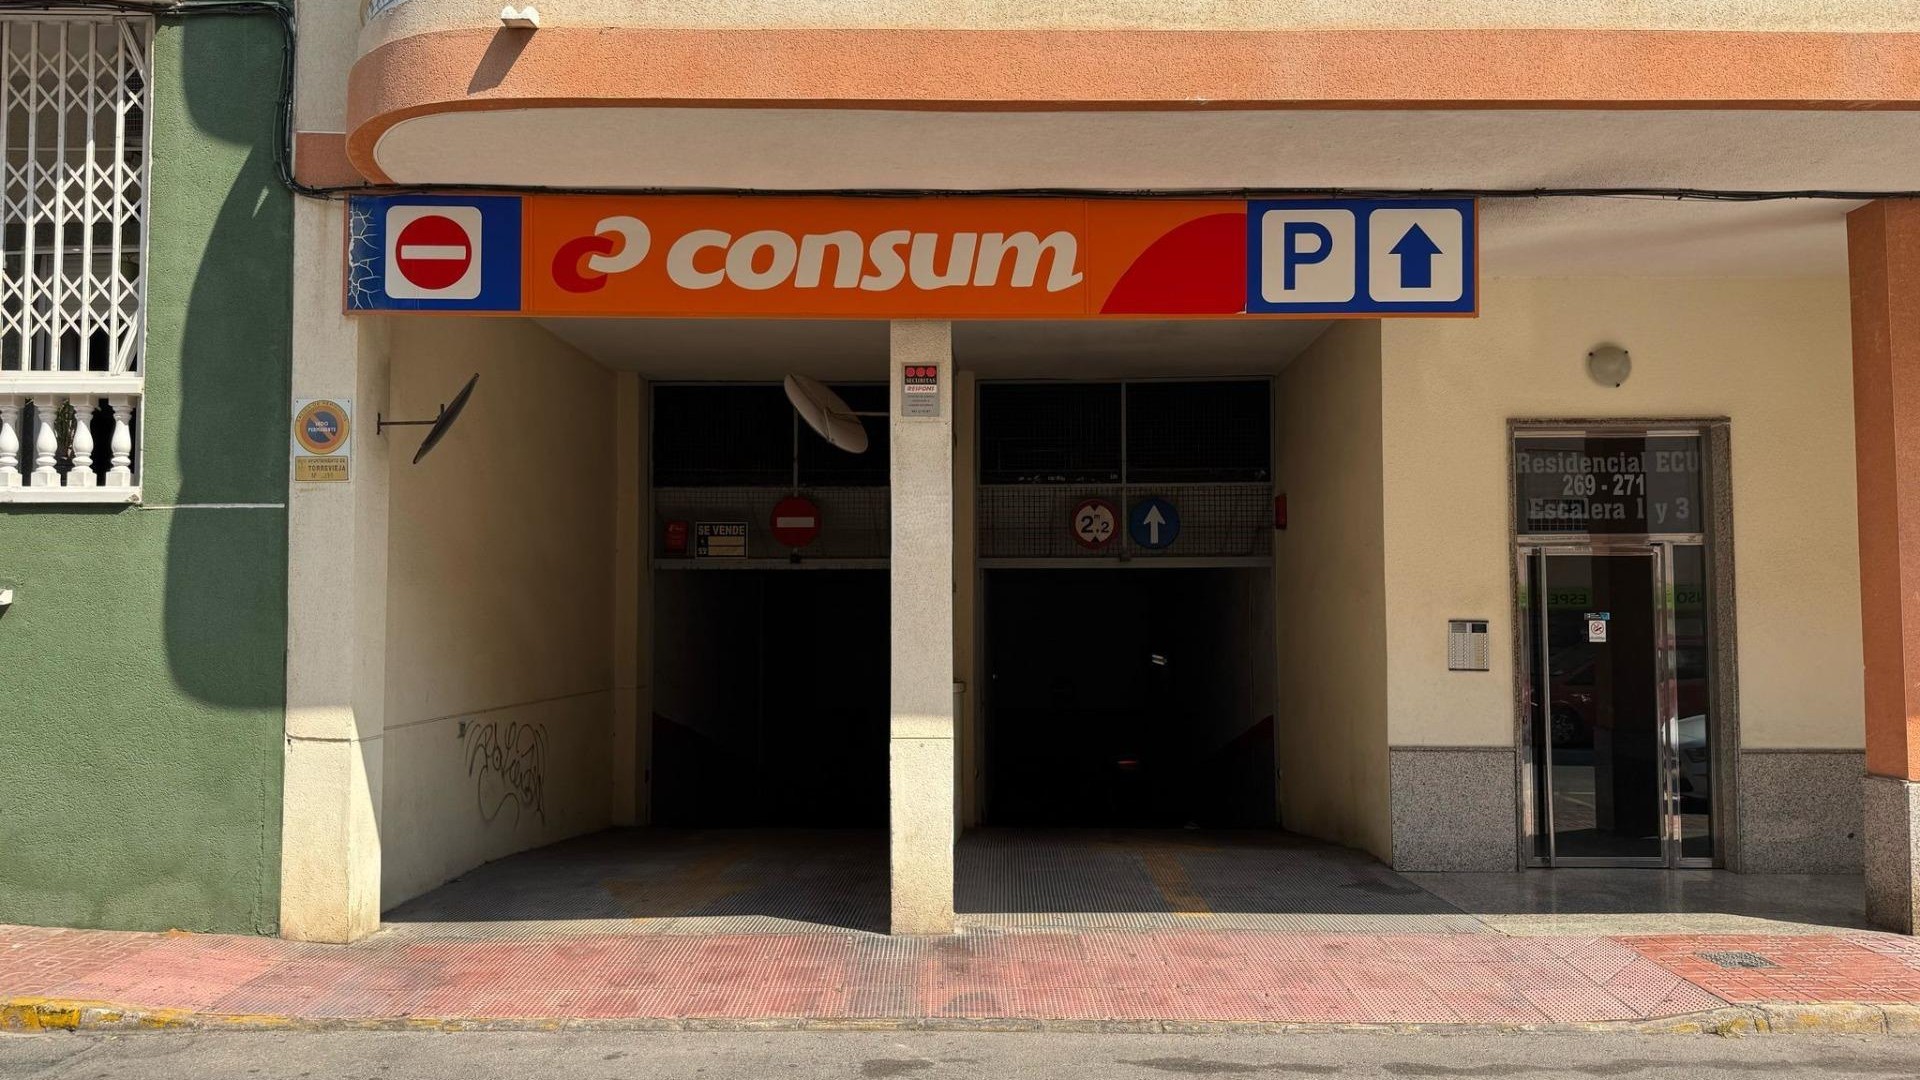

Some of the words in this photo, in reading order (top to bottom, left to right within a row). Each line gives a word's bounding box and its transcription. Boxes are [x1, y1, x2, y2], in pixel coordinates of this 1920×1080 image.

[666, 228, 1084, 292] consum
[1284, 222, 1334, 290] P
[1516, 451, 1648, 473] Residencial
[1562, 474, 1596, 496] 269
[1613, 474, 1646, 496] 271
[1528, 498, 1626, 519] Escalera
[1655, 502, 1669, 524] y
[1676, 498, 1690, 518] 3
[698, 525, 710, 536] SE
[713, 525, 745, 536] VENDE
